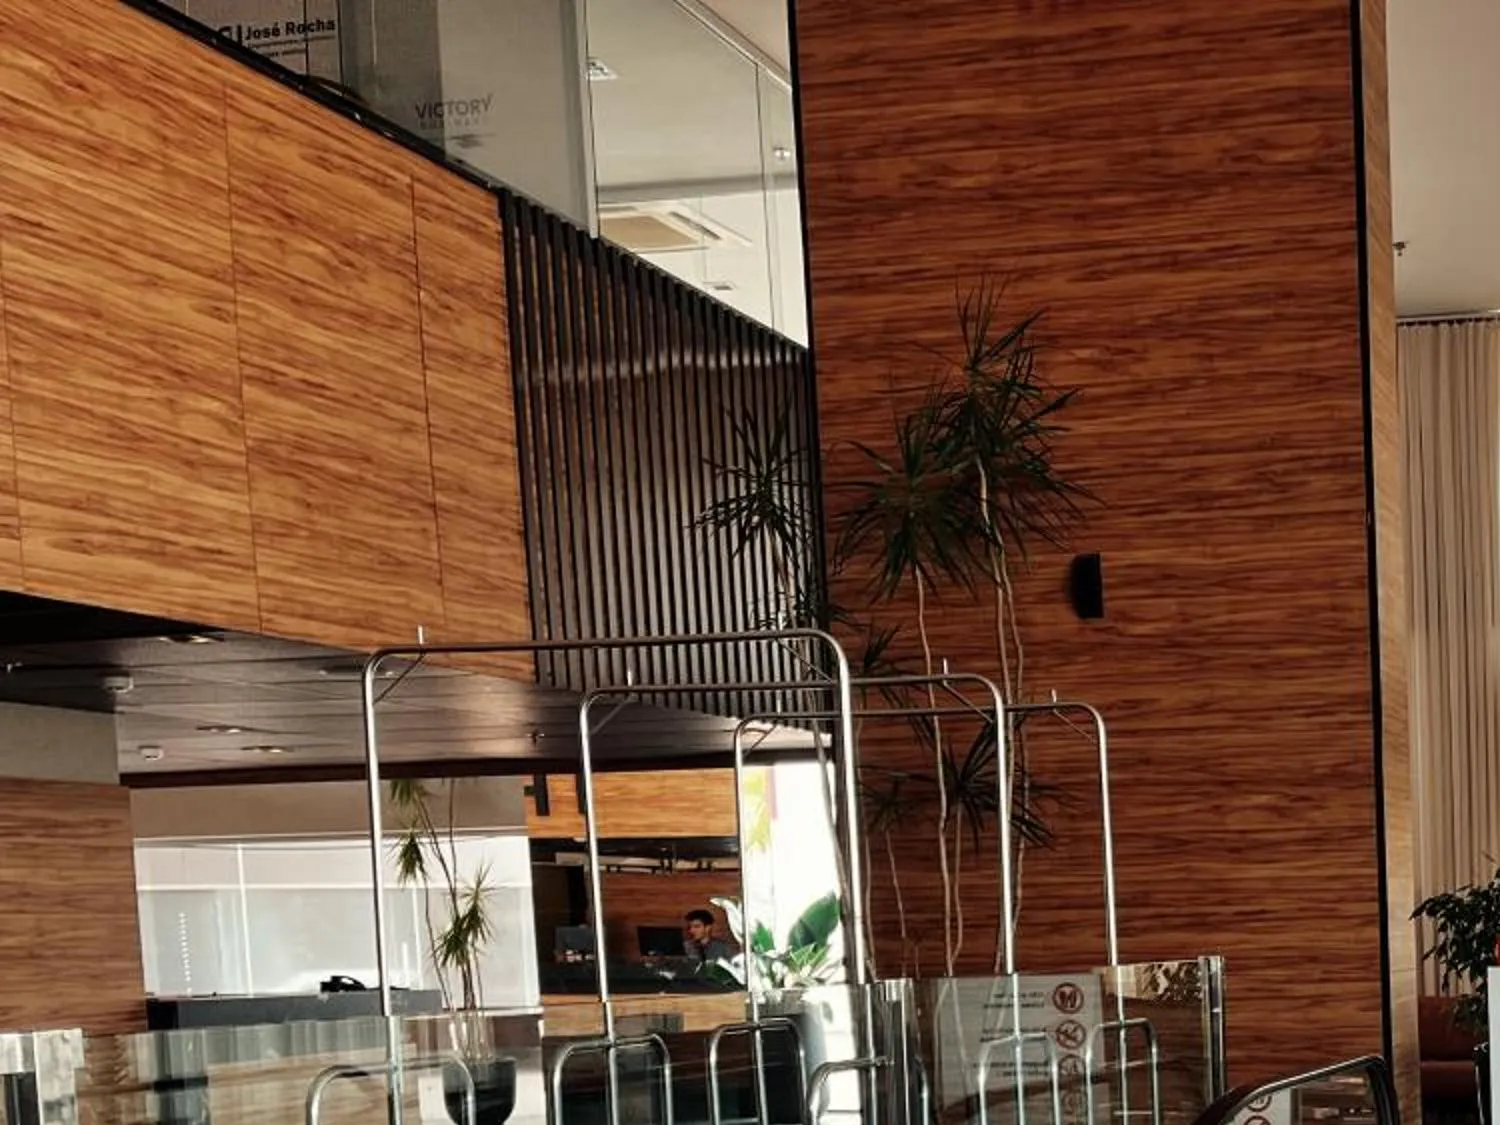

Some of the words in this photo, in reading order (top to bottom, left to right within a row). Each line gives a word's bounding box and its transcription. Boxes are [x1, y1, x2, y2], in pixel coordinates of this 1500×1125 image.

[245, 22, 281, 40] José
[285, 19, 336, 37] Rocha
[415, 93, 494, 119] VICTORY
